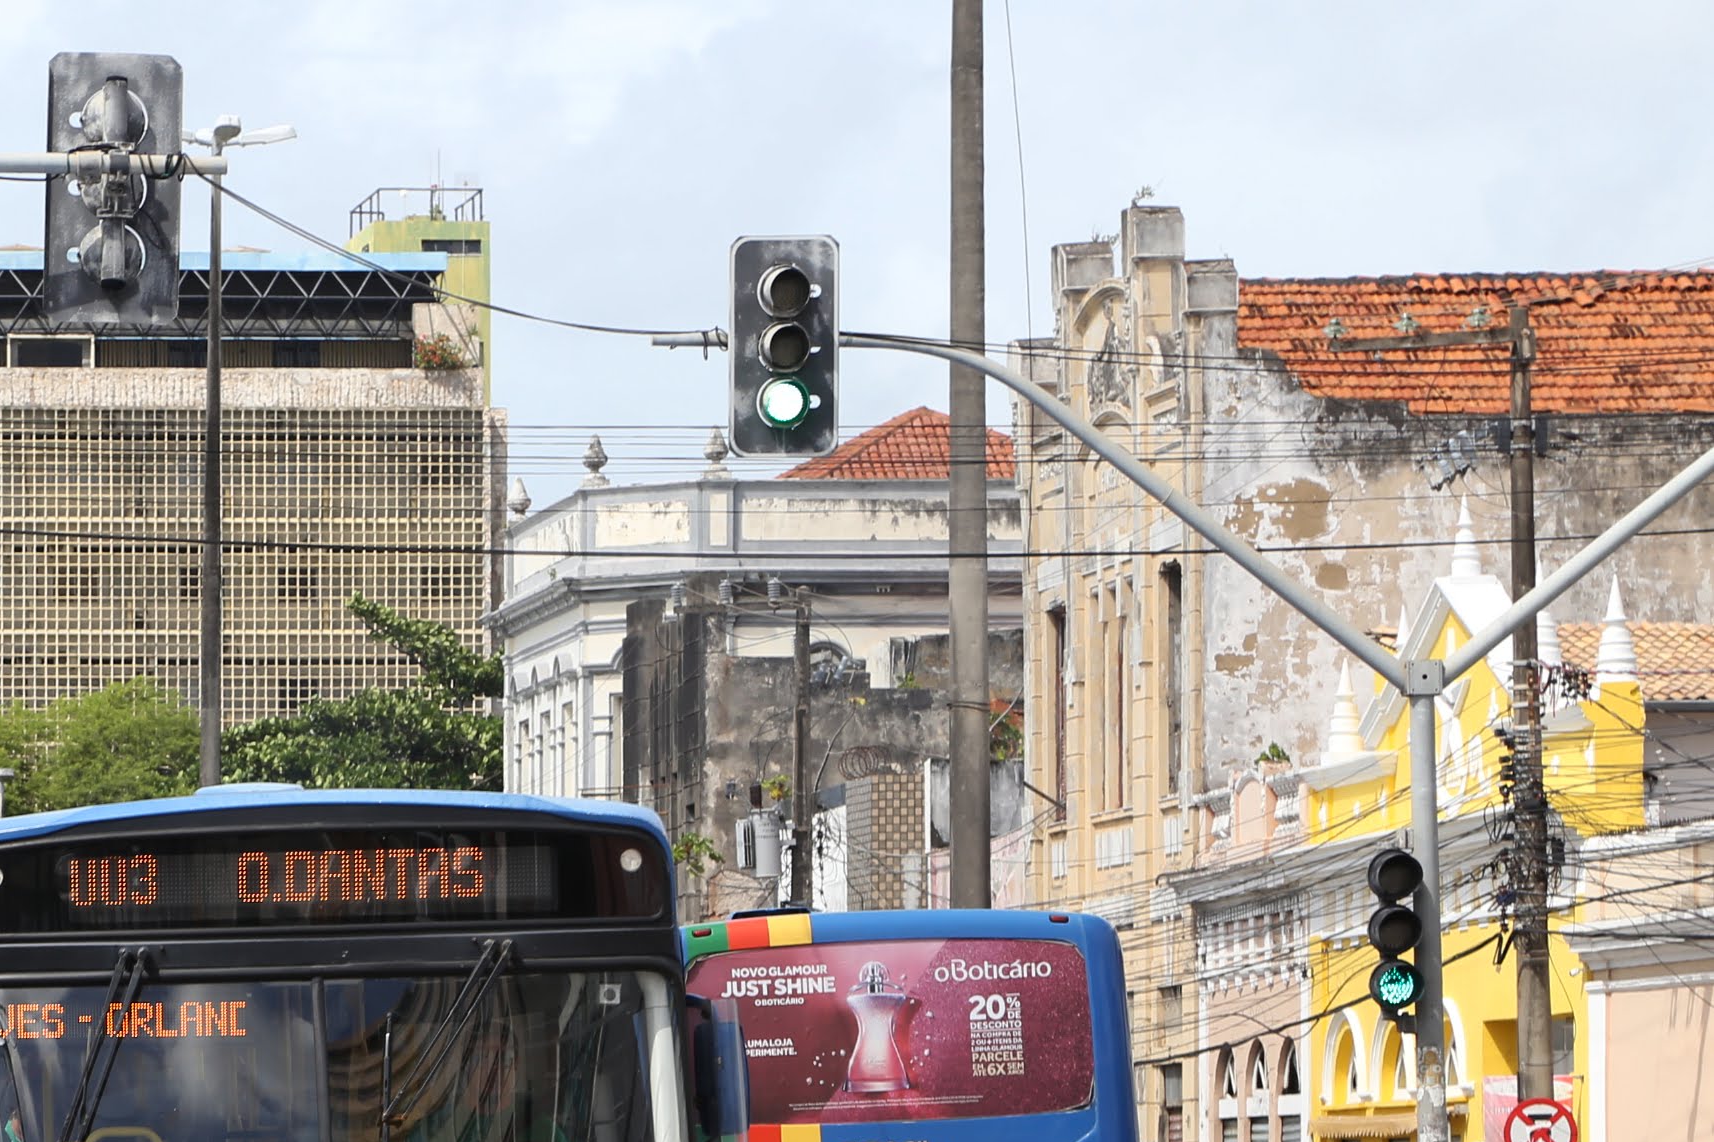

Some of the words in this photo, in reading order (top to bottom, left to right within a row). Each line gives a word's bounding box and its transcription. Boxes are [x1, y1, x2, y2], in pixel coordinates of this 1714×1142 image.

[731, 967, 767, 978] NOVO
[768, 964, 828, 976] GLAMOUR
[721, 979, 772, 998] JUST
[774, 976, 837, 996] SHINE
[969, 1020, 1022, 1030] DESCONTO
[972, 1051, 1024, 1063] PARCELE
[987, 1062, 1006, 1077] 6X
